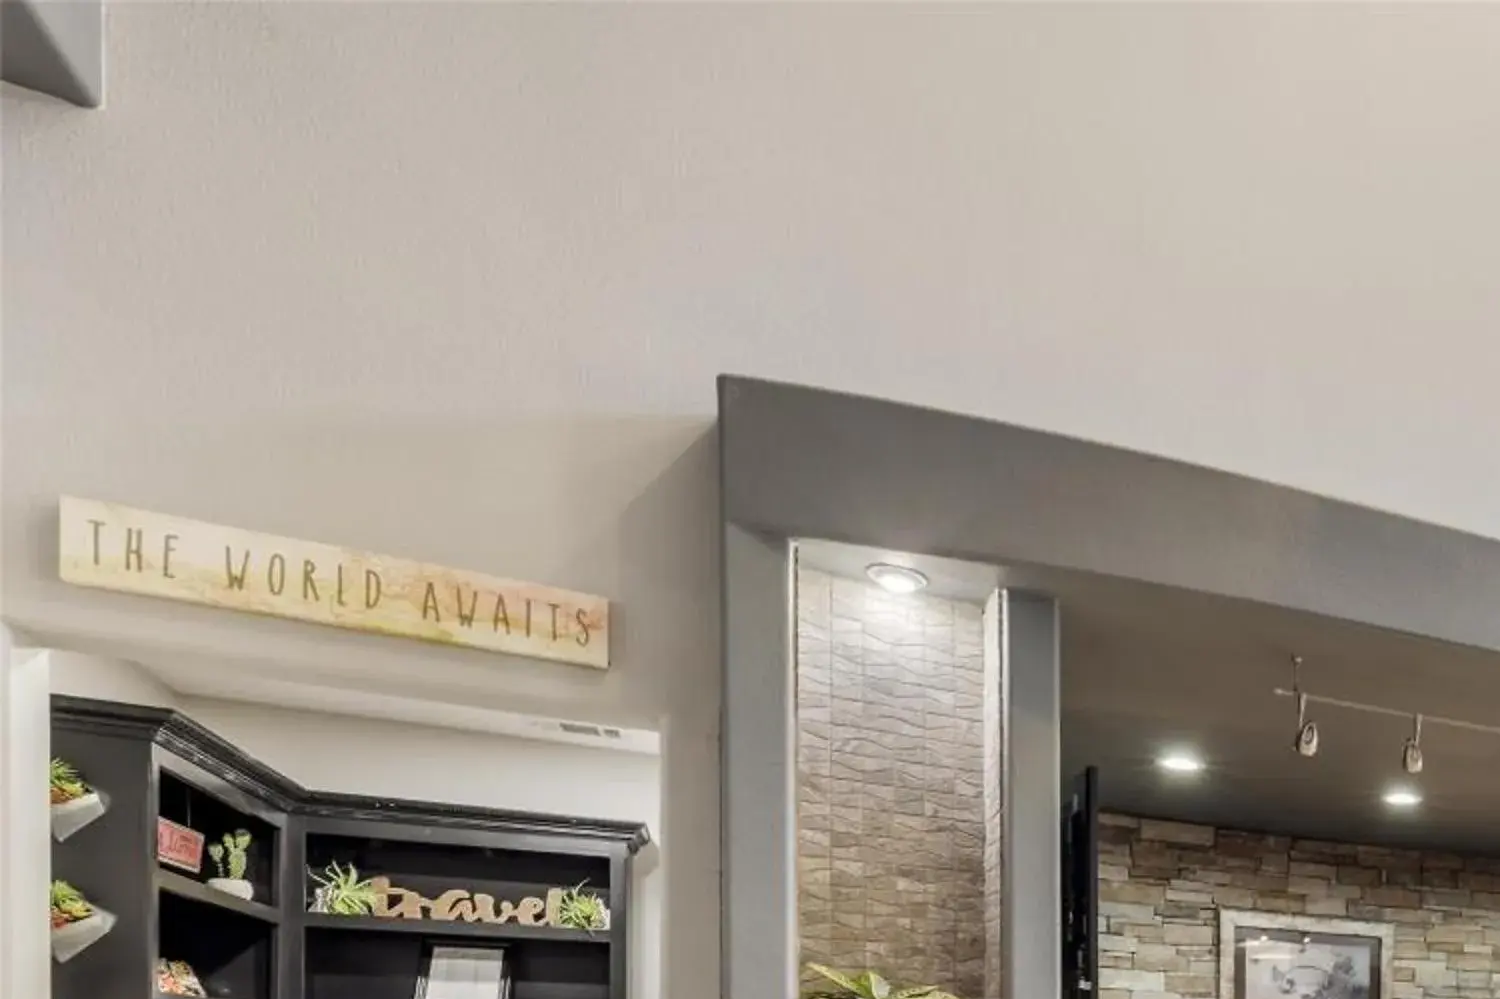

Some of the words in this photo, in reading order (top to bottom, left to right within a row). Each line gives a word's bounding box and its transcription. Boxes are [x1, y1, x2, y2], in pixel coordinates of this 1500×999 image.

[88, 519, 179, 579] THE
[225, 545, 382, 611] WORLD
[421, 581, 592, 647] AWAITS
[371, 875, 563, 928] travel
